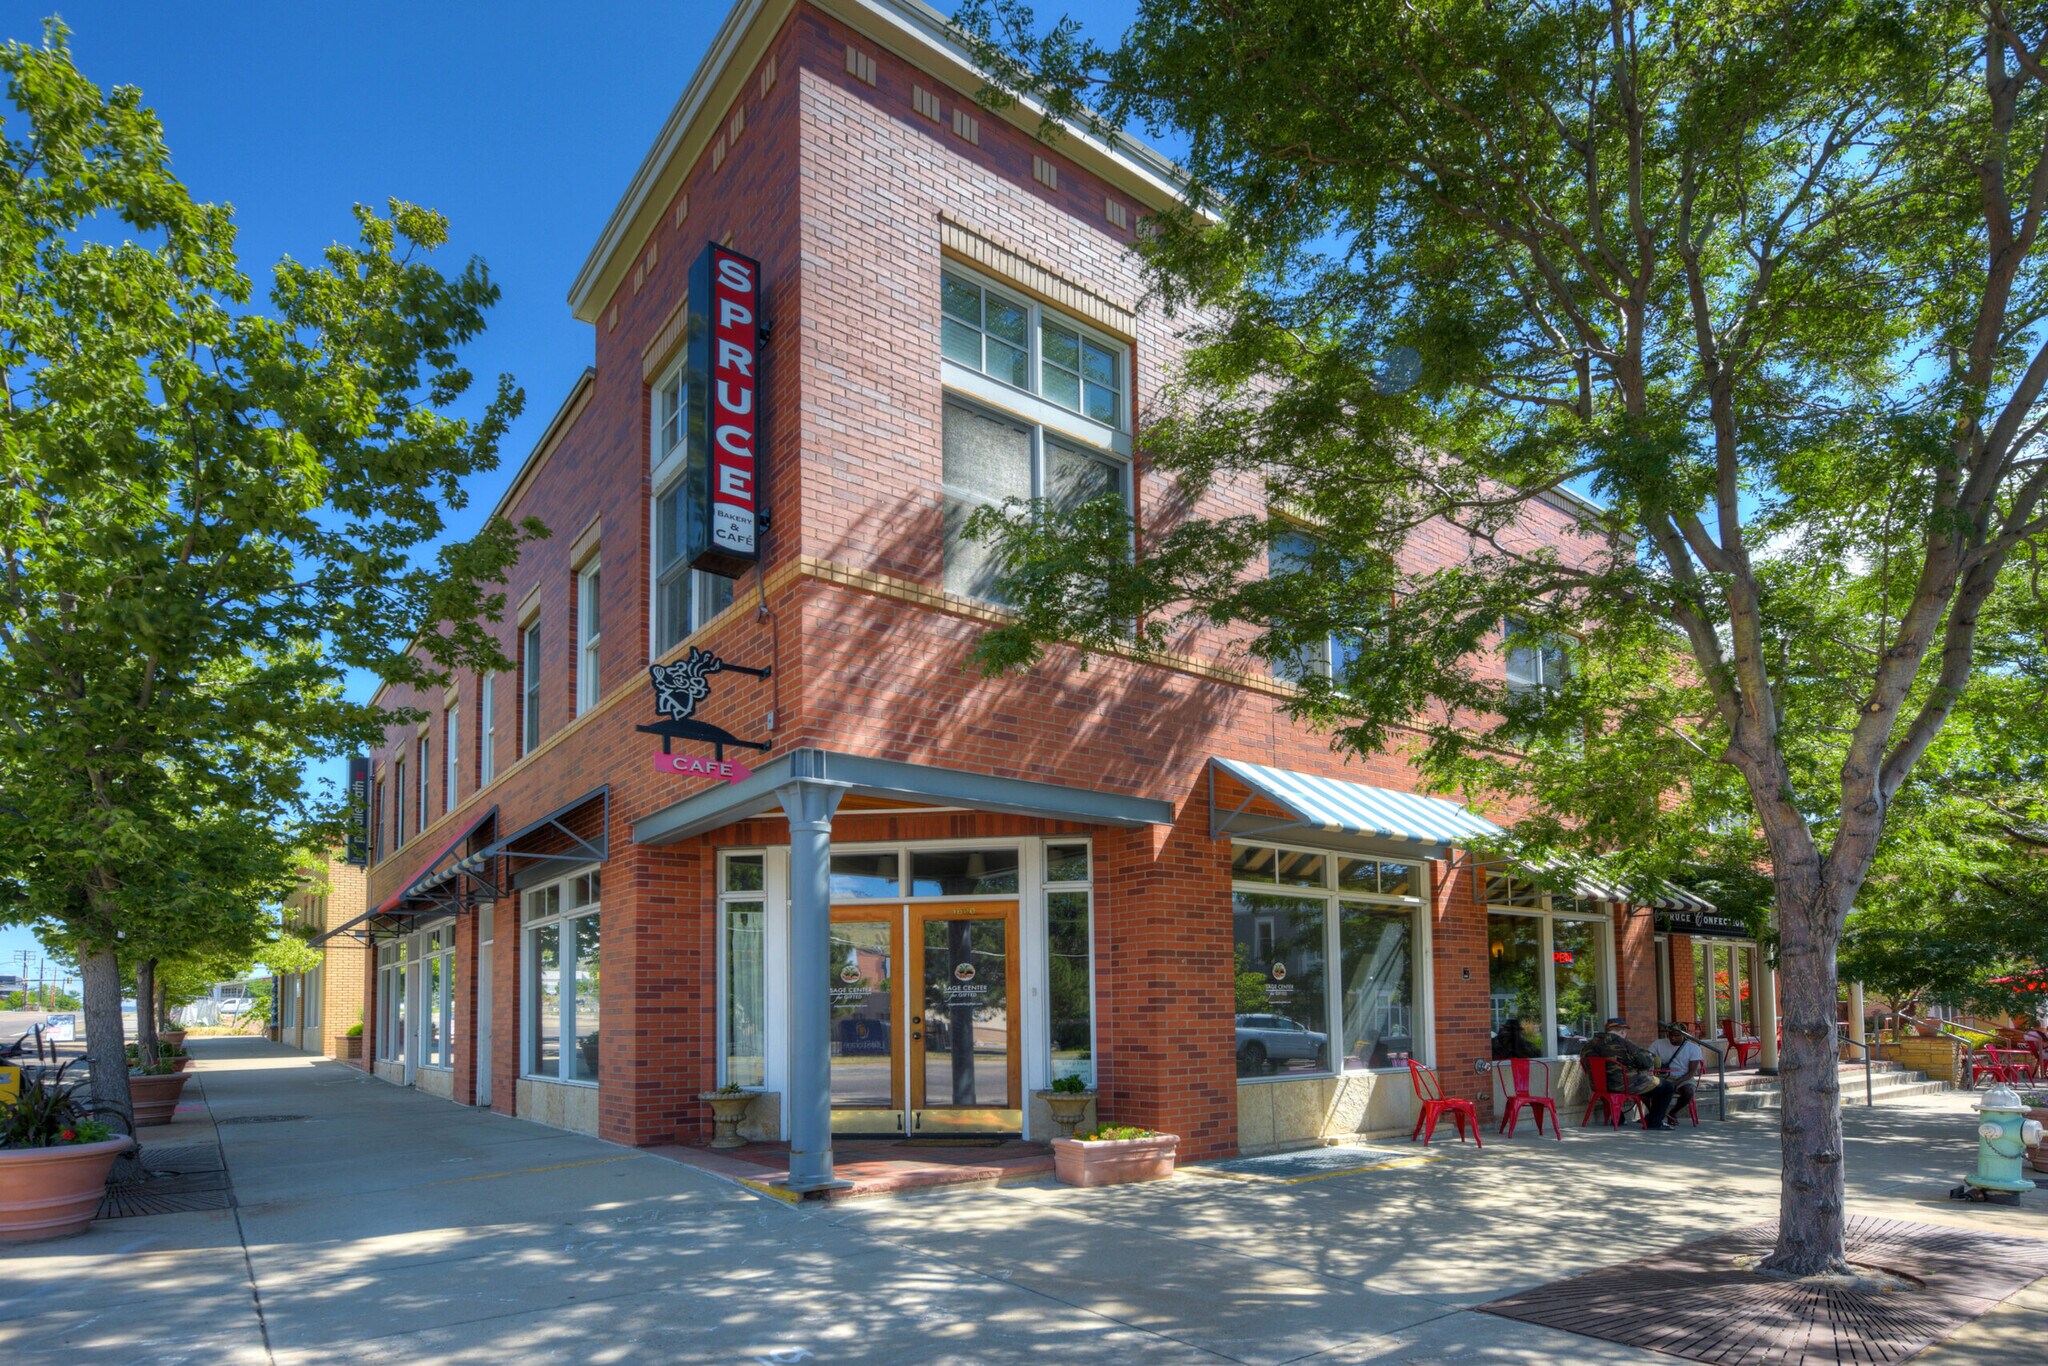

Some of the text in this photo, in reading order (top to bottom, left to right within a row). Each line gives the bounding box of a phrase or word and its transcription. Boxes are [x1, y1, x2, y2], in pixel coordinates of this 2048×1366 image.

[716, 258, 753, 501] SPRUCE
[717, 509, 752, 524] BAKERY
[730, 523, 740, 532] &
[716, 529, 753, 546] CAFÉ
[672, 757, 734, 777] CAFE
[1553, 951, 1573, 963] PEN
